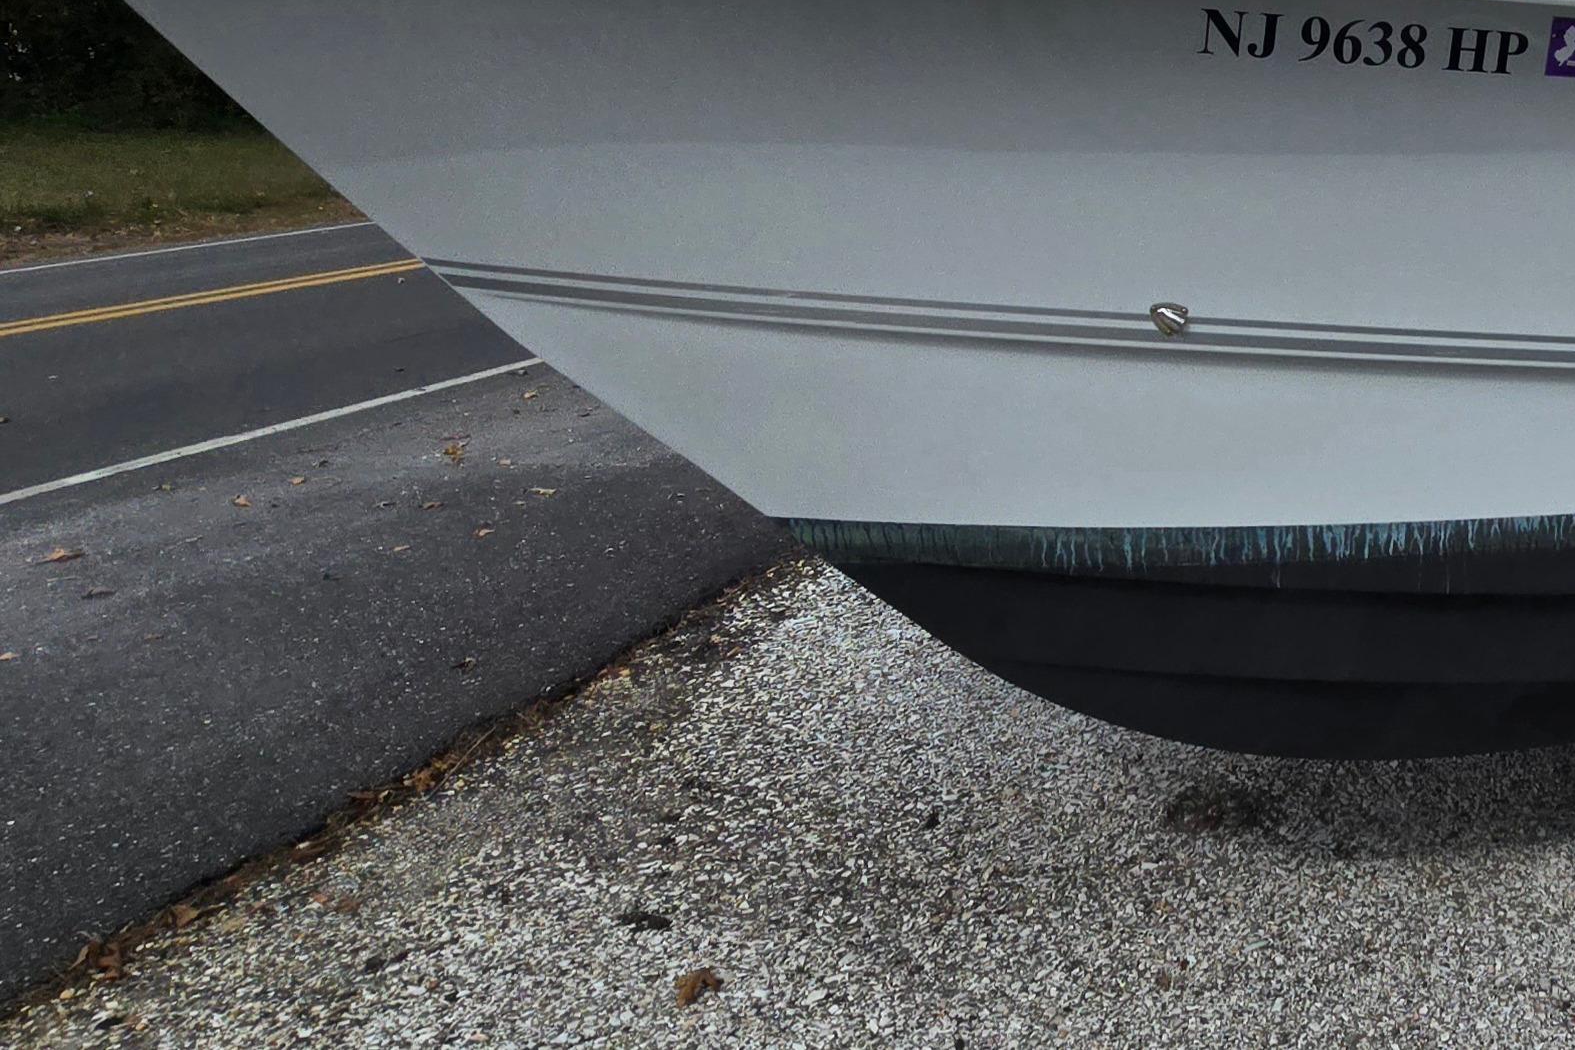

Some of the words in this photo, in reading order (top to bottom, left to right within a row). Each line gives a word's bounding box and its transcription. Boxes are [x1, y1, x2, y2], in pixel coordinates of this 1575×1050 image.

[1197, 7, 1284, 58] NJ
[1298, 15, 1428, 69] 9638
[1441, 26, 1529, 75] HP
